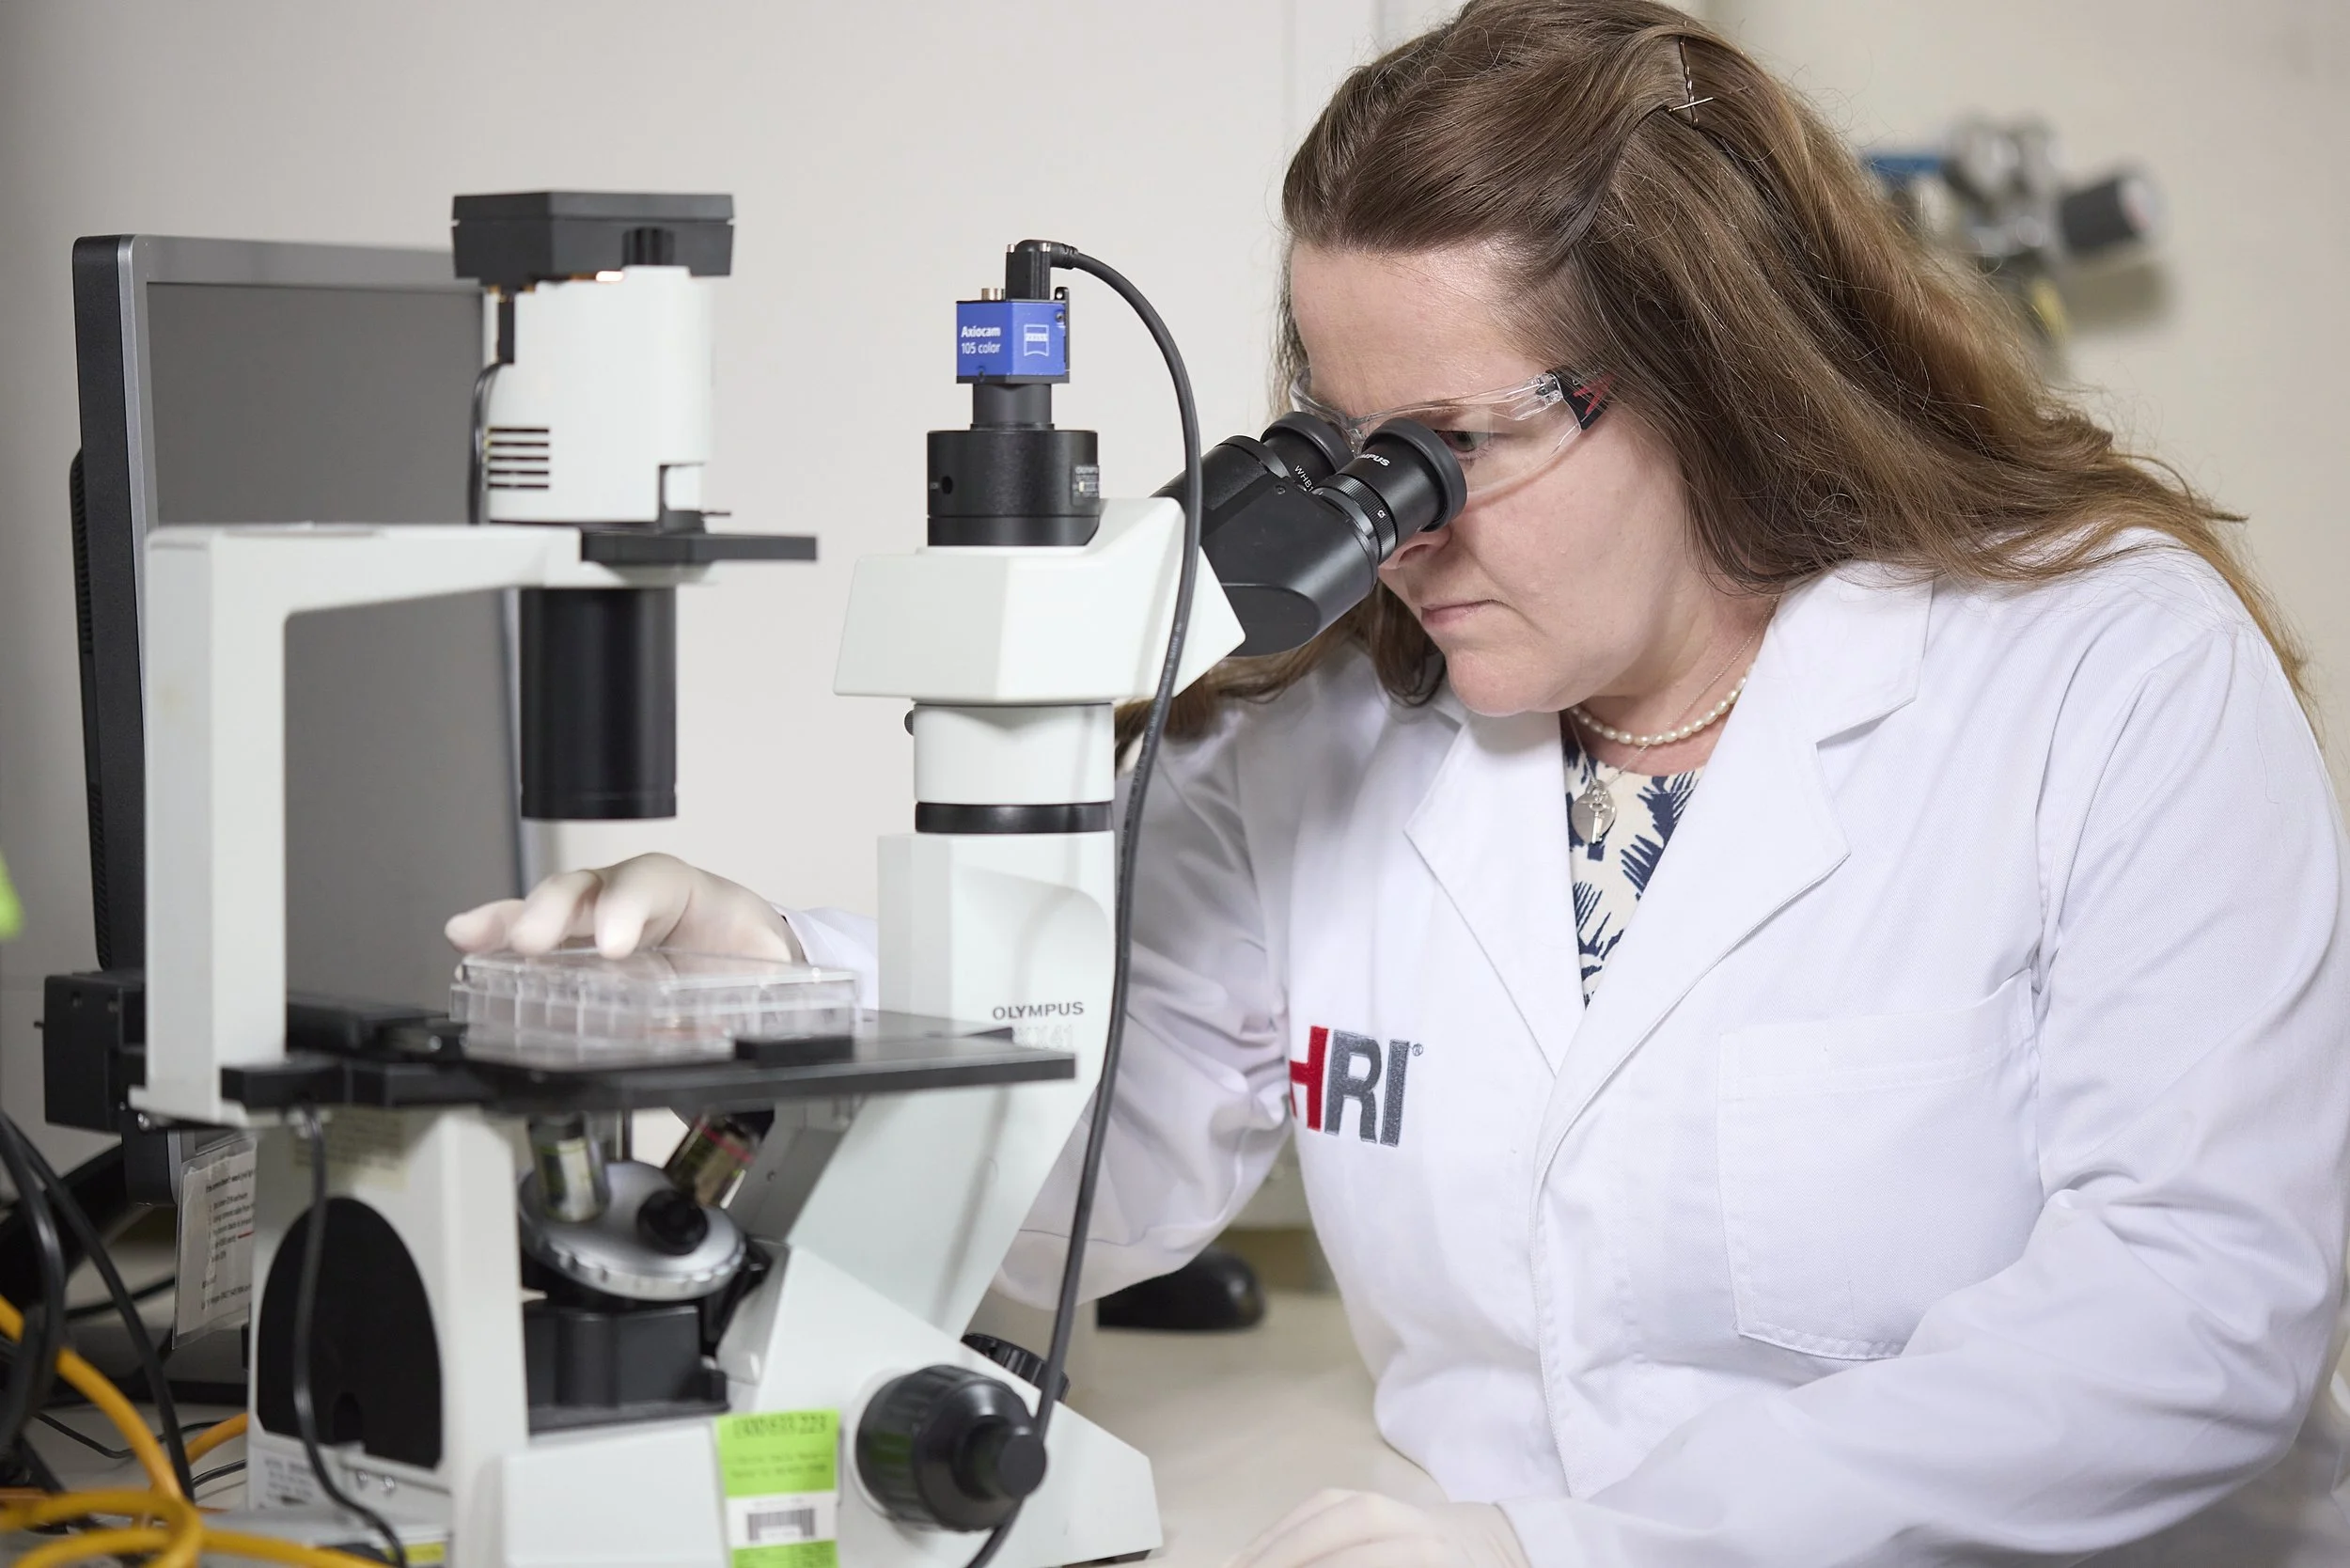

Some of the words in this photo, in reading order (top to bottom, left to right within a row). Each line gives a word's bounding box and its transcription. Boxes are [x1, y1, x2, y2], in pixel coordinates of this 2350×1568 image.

[961, 325, 1001, 338] Axiocam
[961, 341, 977, 354] 105
[978, 340, 1001, 354] color
[993, 1001, 1084, 1020] OLYMPUS
